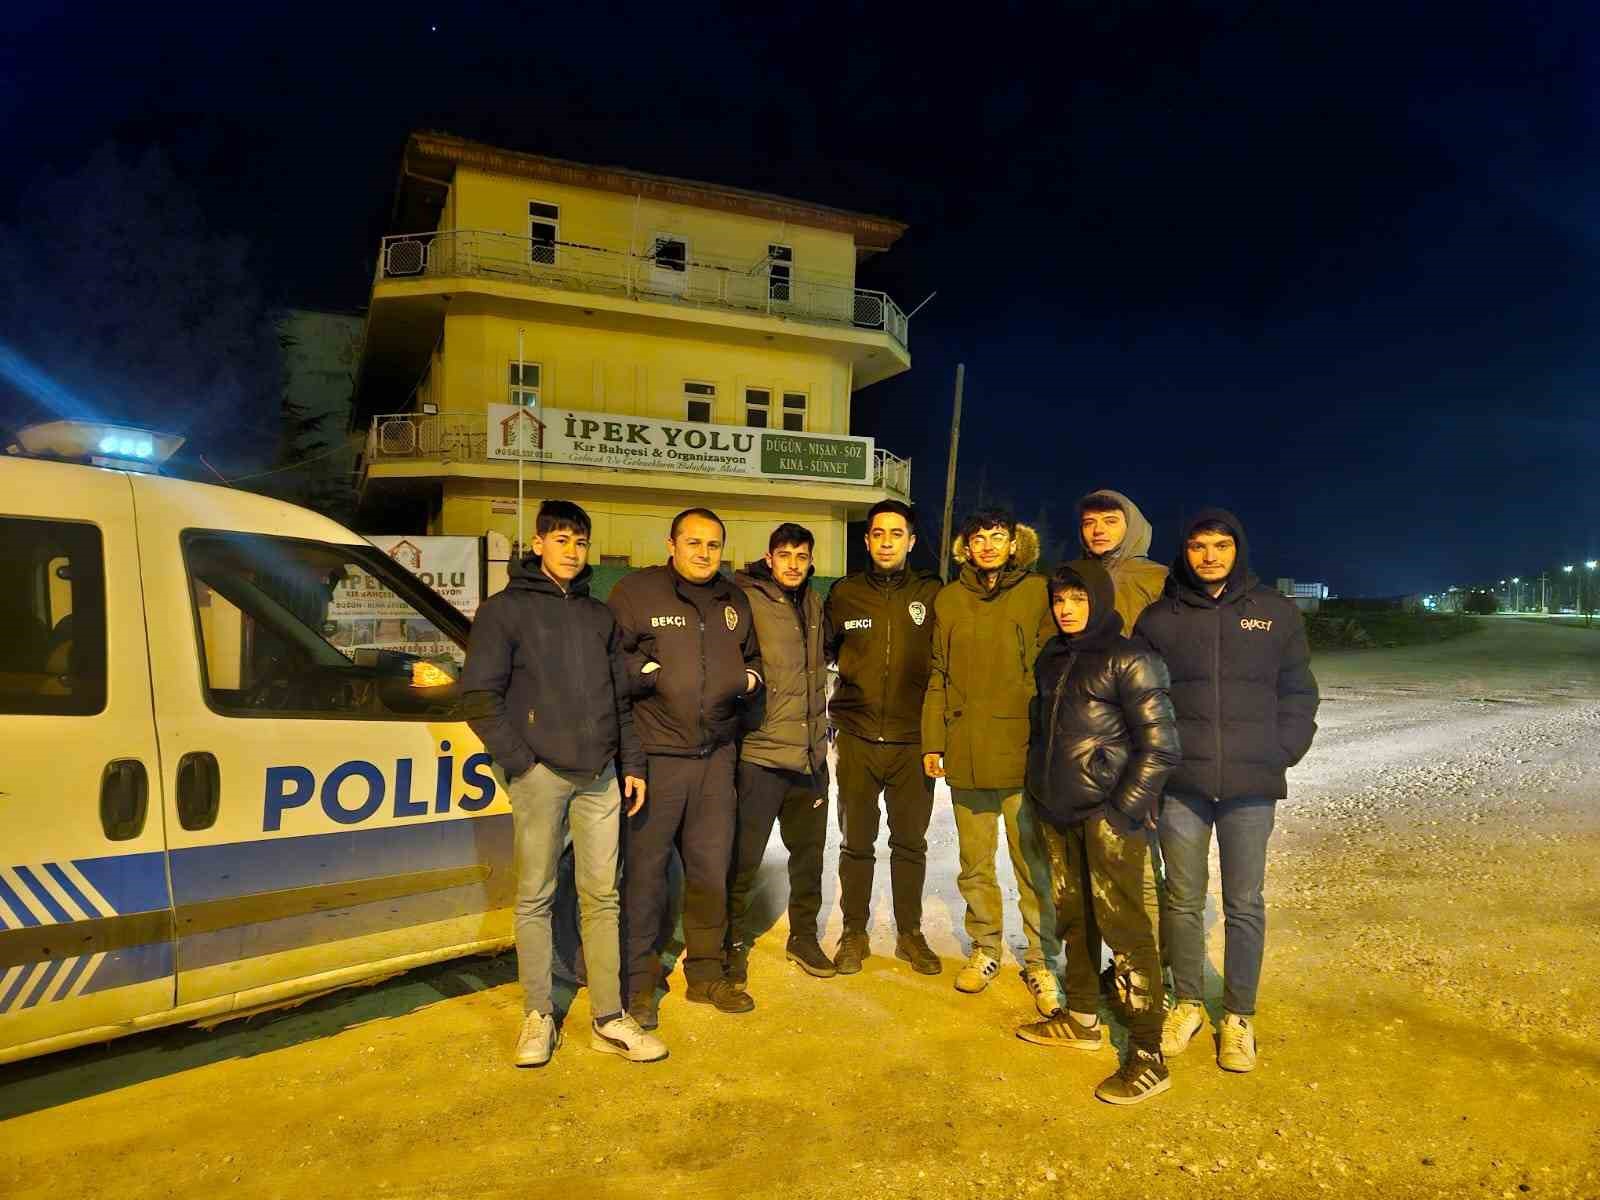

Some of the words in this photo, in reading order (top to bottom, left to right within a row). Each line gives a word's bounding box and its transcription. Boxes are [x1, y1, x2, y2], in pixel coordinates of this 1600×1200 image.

[564, 413, 651, 444] İPEK
[661, 426, 754, 452] YOLU
[573, 441, 595, 452] Kır
[599, 443, 648, 458] Bahçesi
[652, 448, 663, 458] &
[667, 449, 746, 465] Organizasyon
[419, 572, 466, 588] OLU
[651, 615, 686, 628] BEKÇİ
[262, 740, 497, 832] POLİS
